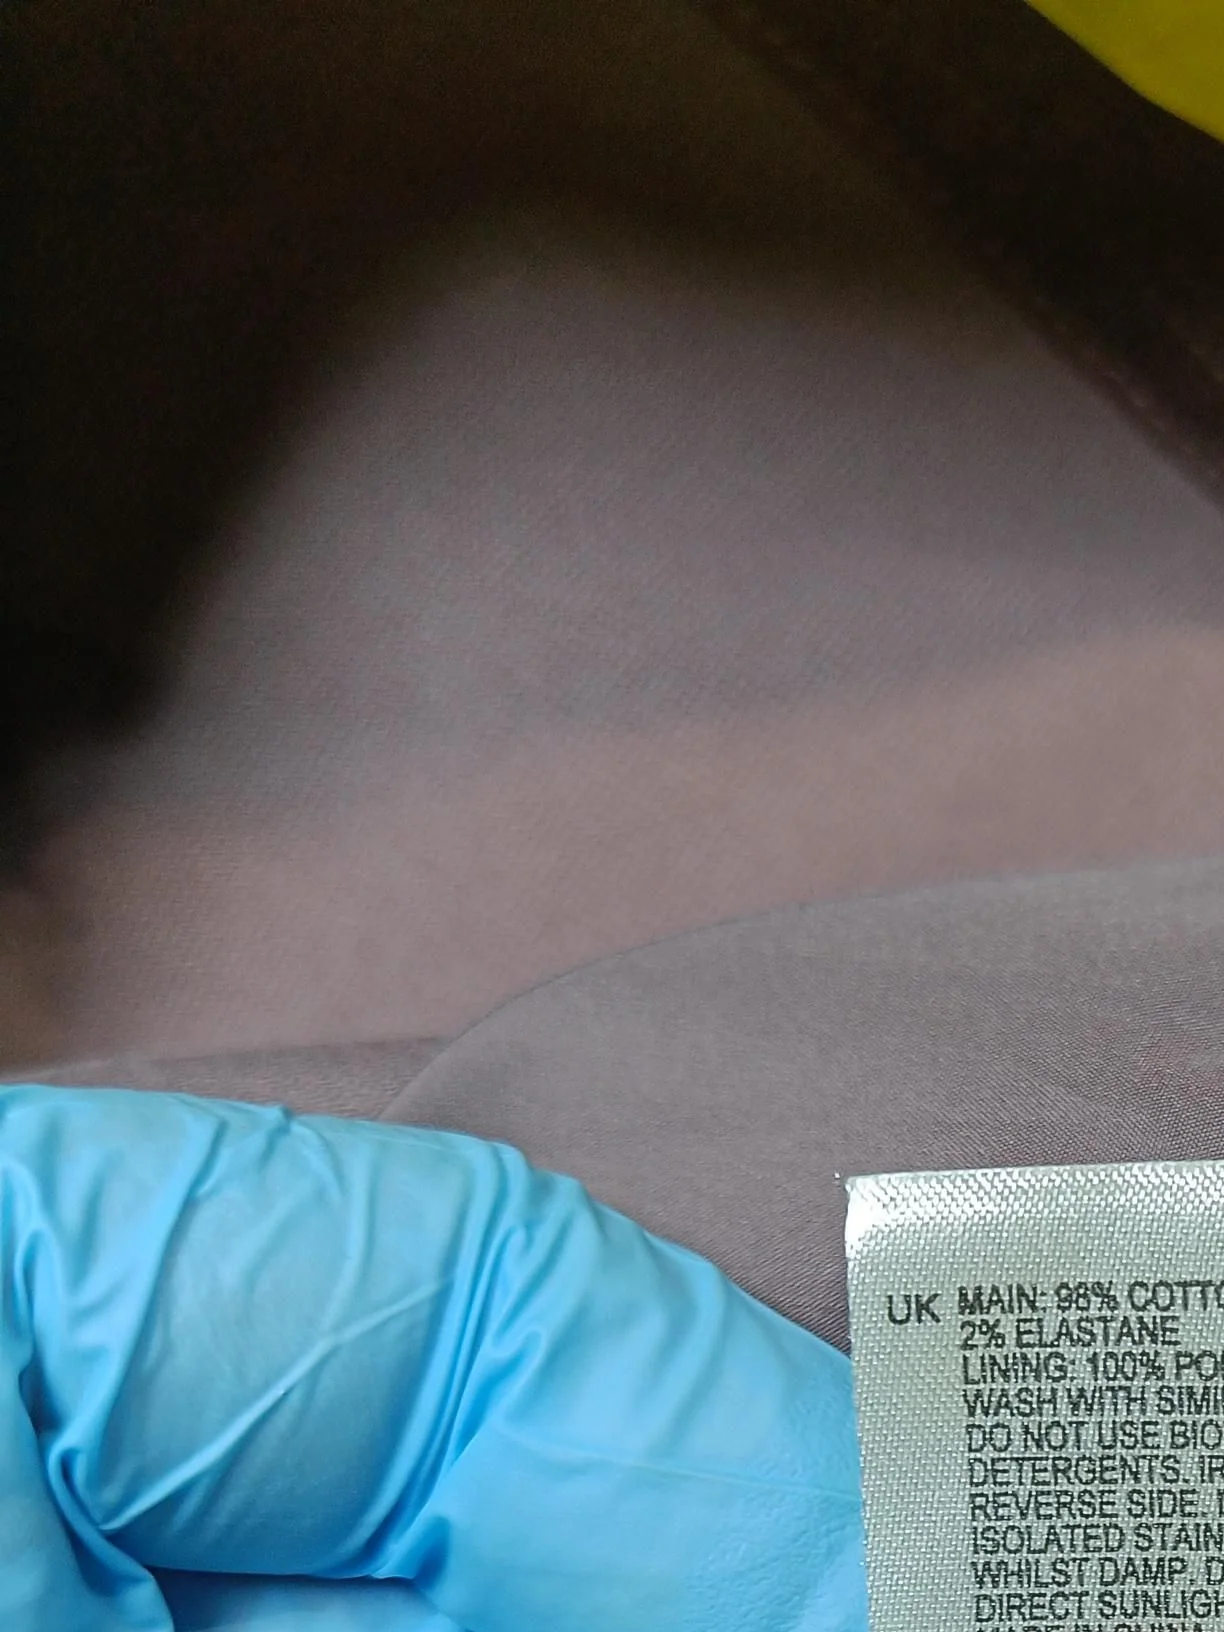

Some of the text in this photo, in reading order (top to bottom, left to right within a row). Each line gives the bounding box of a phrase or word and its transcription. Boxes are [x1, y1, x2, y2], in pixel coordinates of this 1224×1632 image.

[888, 1294, 940, 1326] UK
[959, 1282, 1046, 1316] MAIN:
[1057, 1281, 1119, 1312] 98%
[961, 1316, 1180, 1349] 2% ELASTANE
[961, 1354, 1075, 1385] LINING:
[1087, 1352, 1164, 1382] 100%
[963, 1388, 1058, 1418] WASH
[1067, 1386, 1145, 1416] WITH
[968, 1423, 1010, 1453] DO
[1023, 1422, 1088, 1451] NOT
[1099, 1420, 1159, 1450] USE
[969, 1456, 1190, 1487] DETERGENTS.
[972, 1492, 1116, 1522] REVERSE
[1127, 1490, 1208, 1519] SIDE.
[973, 1525, 1124, 1556] ISOLATED
[972, 1559, 1088, 1590] WHILST
[1099, 1558, 1195, 1588] DAMP.
[975, 1593, 1086, 1623] DIRECT
